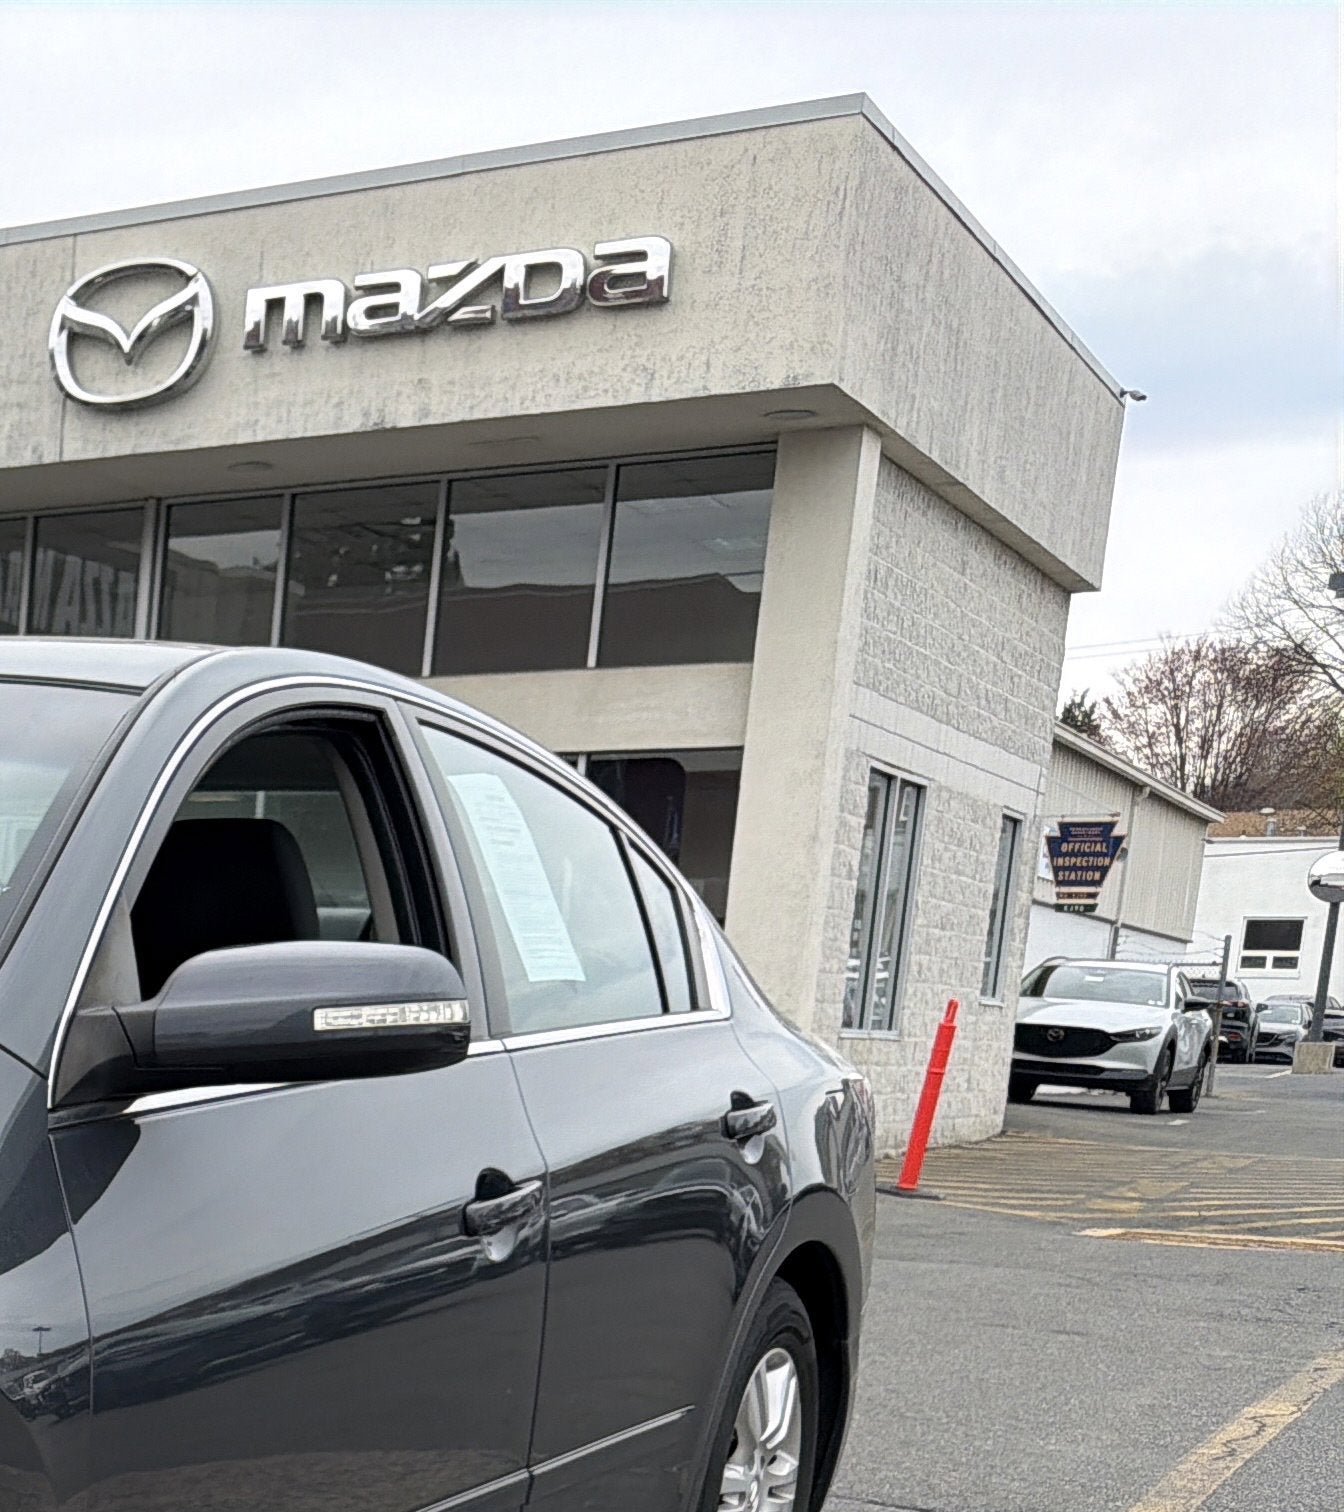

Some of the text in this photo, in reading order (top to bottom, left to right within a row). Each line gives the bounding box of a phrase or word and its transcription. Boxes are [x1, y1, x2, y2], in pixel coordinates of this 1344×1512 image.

[242, 235, 674, 352] mazda
[1060, 842, 1108, 853] OFFICIAL
[1053, 856, 1111, 867] INSPECTION
[1058, 870, 1101, 881] STATION
